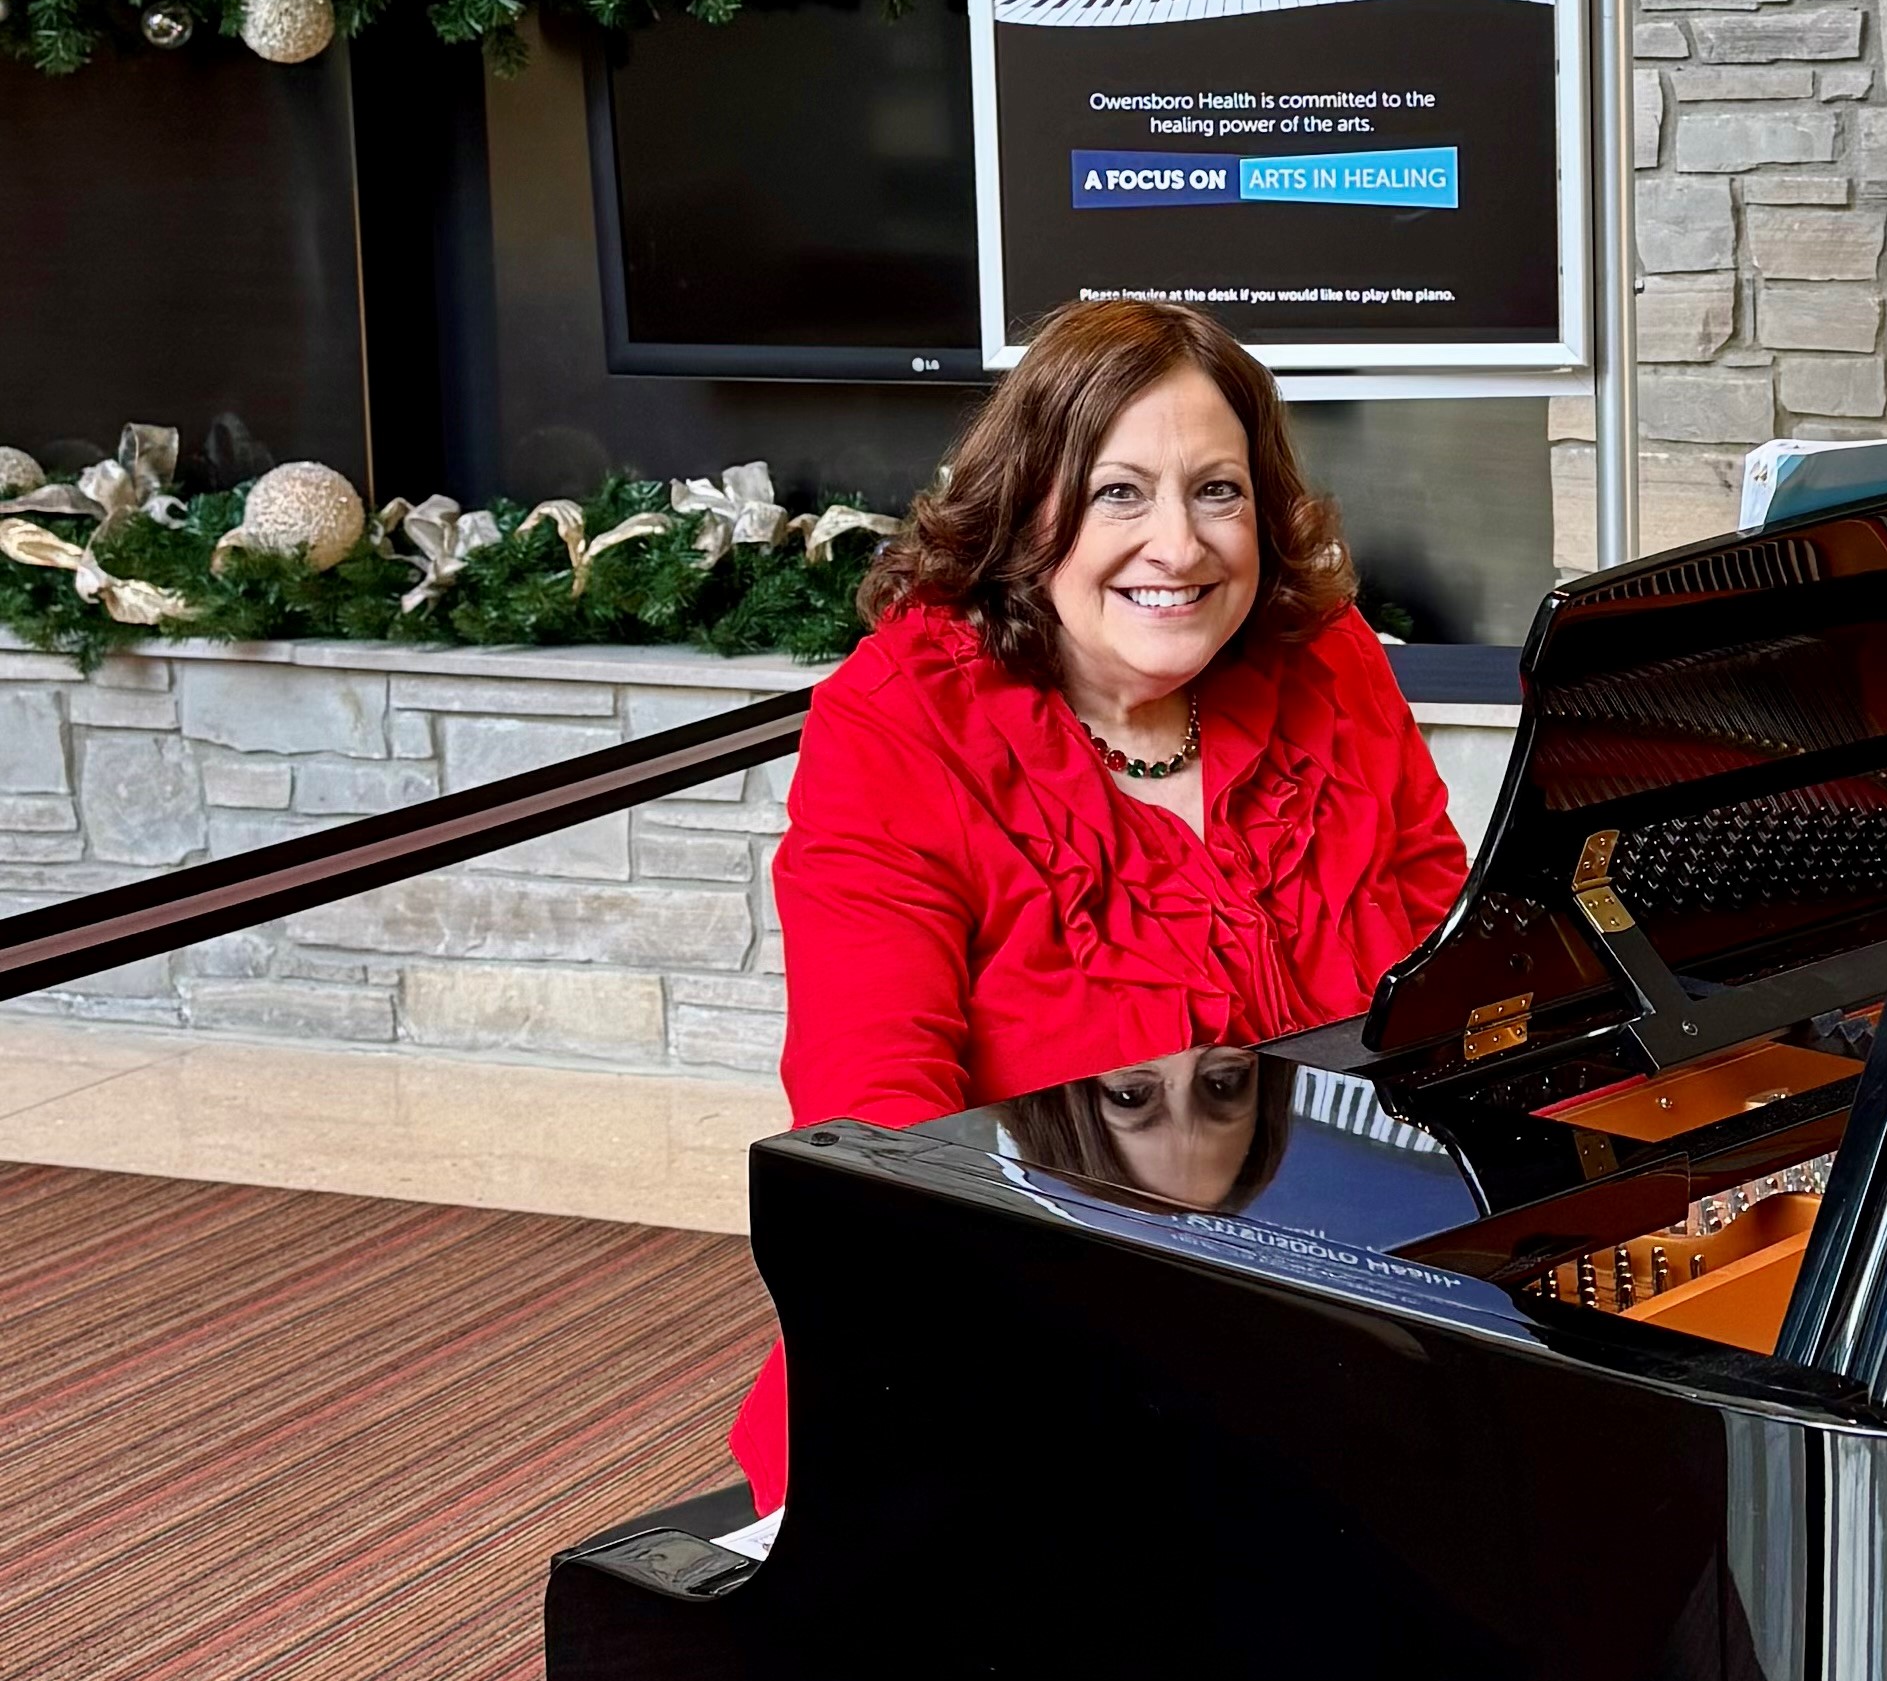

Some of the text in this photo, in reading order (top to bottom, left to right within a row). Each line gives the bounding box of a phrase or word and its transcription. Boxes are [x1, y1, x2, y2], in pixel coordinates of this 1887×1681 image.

[1089, 90, 1435, 110] Owensboro Health is committed to the
[1150, 116, 1375, 137] healing power of the arts.
[1084, 167, 1446, 191] A FOCUS ON ARTS IN HEALING
[1080, 288, 1121, 301] Please
[1168, 289, 1183, 301] at
[1184, 288, 1206, 301] the
[1207, 288, 1238, 301] desk
[1239, 288, 1249, 301] if
[1251, 290, 1275, 304] you
[1277, 289, 1318, 301] would
[1320, 288, 1343, 301] like
[1345, 289, 1360, 301] to
[1362, 288, 1389, 304] play
[1391, 288, 1414, 301] the
[1415, 288, 1455, 304] piano.
